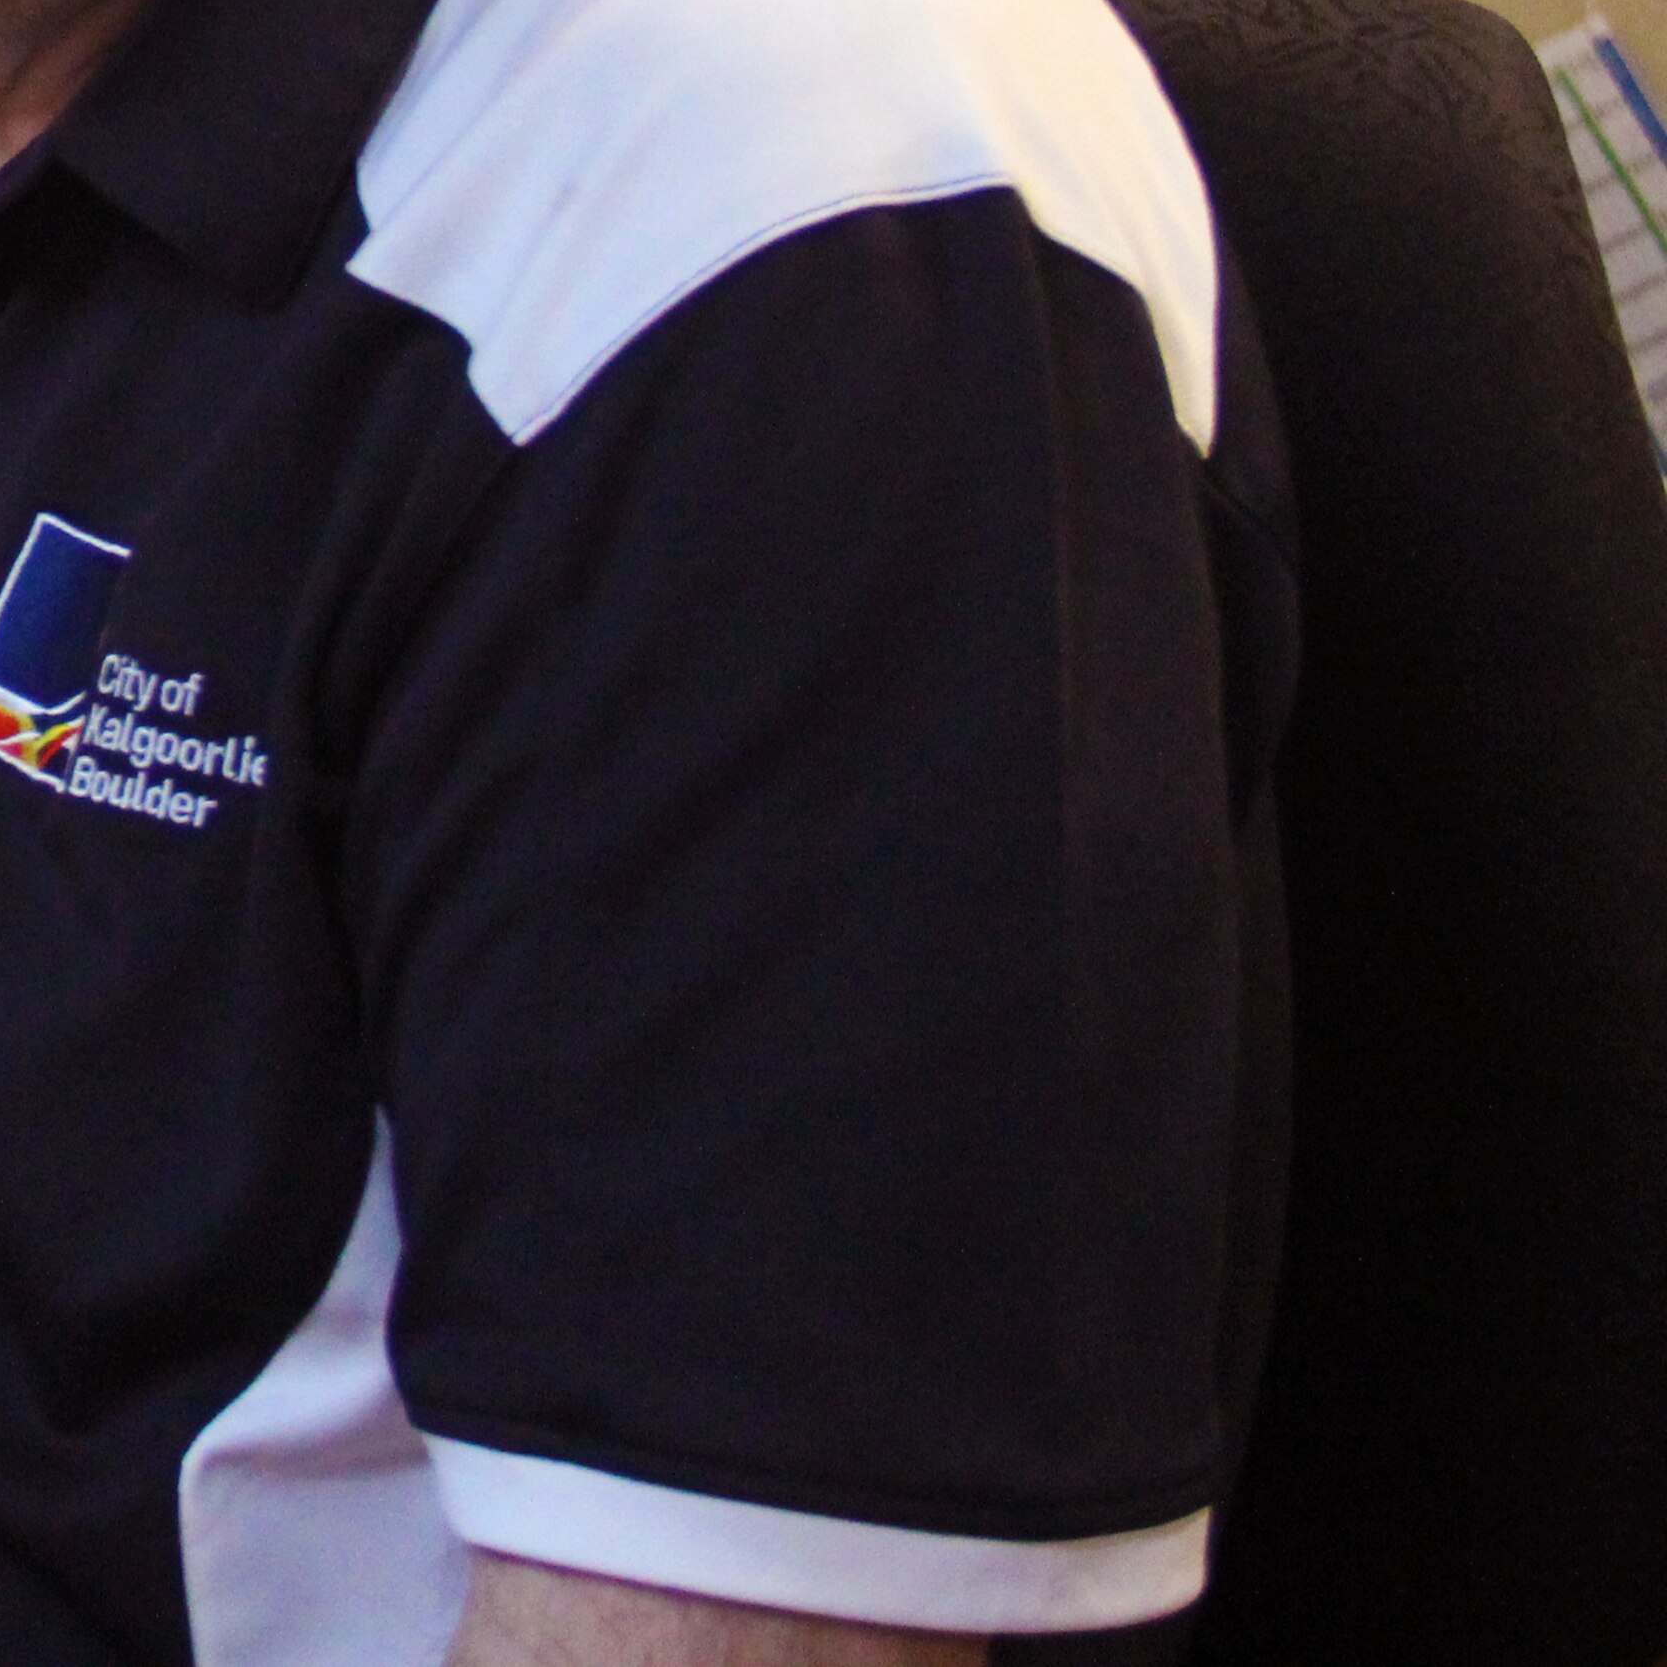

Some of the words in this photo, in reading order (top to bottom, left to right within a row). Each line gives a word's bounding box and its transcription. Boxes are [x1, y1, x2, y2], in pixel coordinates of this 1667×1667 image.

[97, 653, 160, 712] City
[160, 672, 206, 716] of
[81, 702, 269, 787] Kalgoorlie
[68, 755, 218, 829] Boulder
